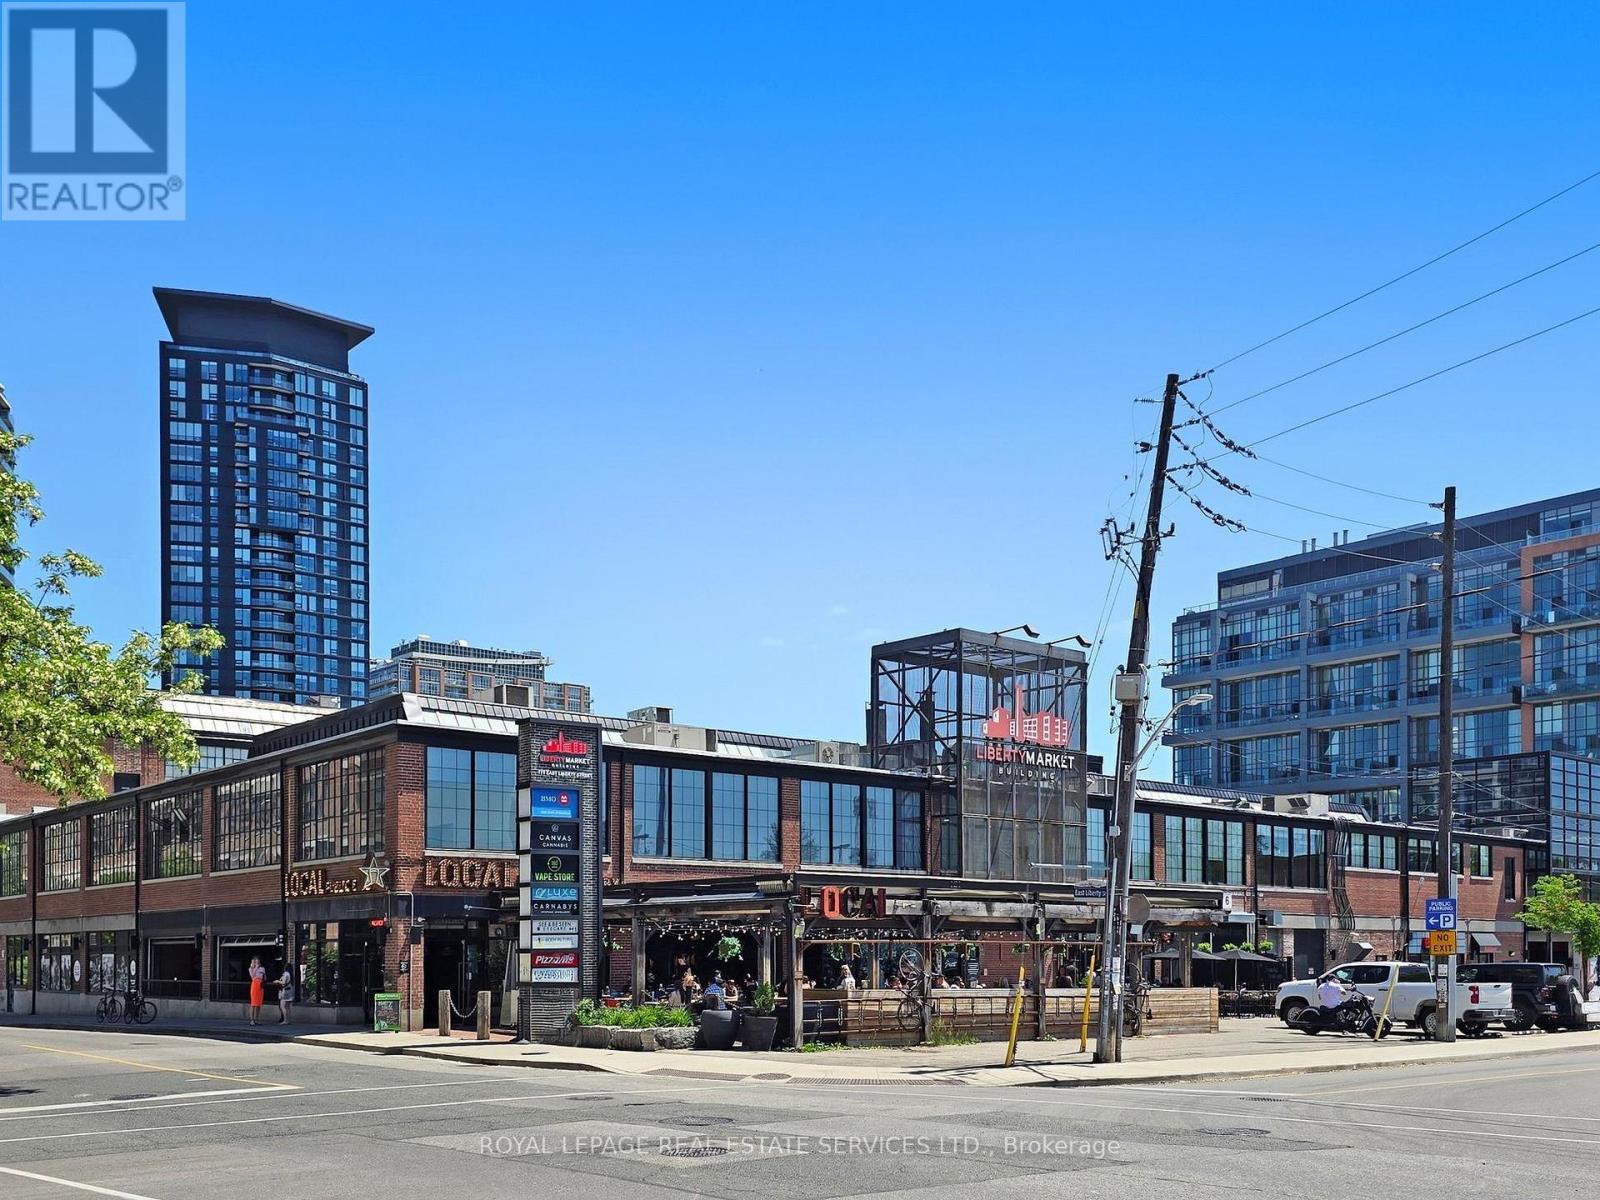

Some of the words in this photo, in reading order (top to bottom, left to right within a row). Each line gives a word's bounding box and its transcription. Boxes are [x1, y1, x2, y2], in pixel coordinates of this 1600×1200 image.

[998, 767, 1056, 780] BUILDING
[540, 795, 557, 803] BMO
[539, 834, 572, 842] CANVAS
[425, 859, 516, 888] LOCAL
[534, 872, 553, 881] VAPE
[553, 872, 576, 881] STORE
[284, 869, 325, 897] LOCAL
[1085, 889, 1101, 897] Liberty
[1225, 896, 1230, 906] 6
[1433, 944, 1453, 952] EXIT
